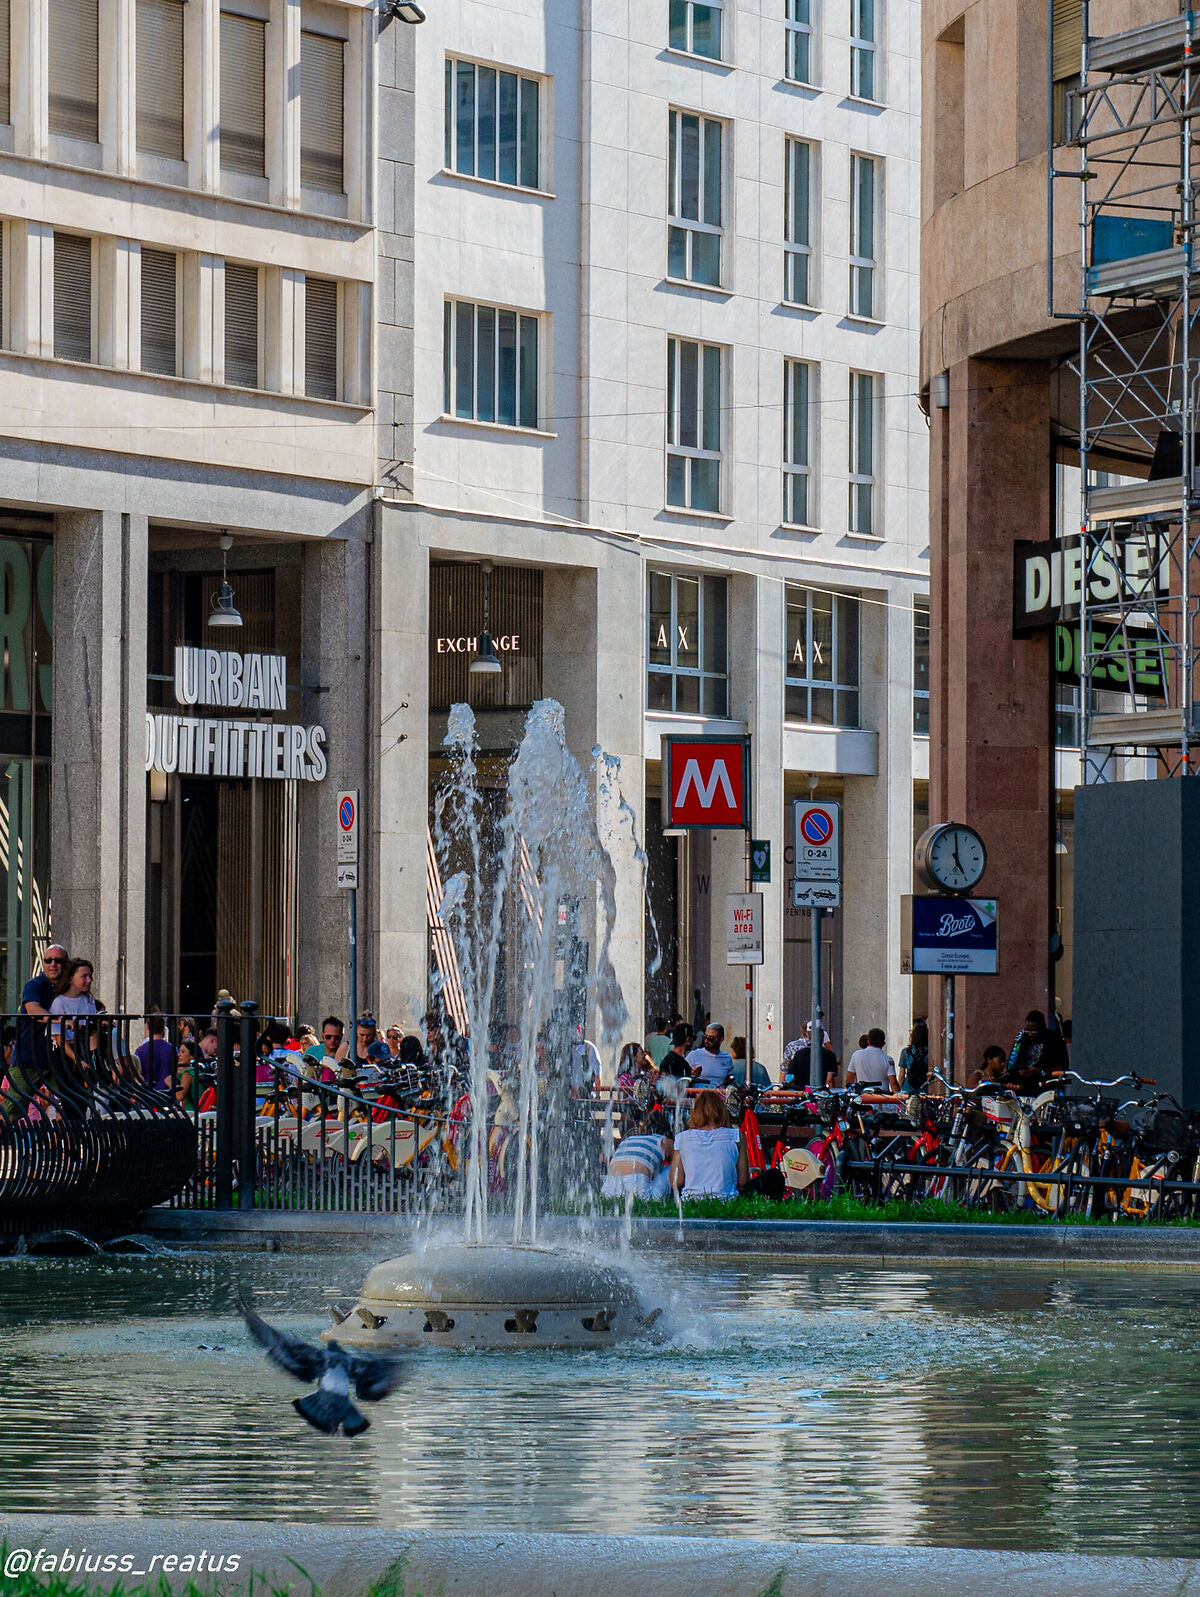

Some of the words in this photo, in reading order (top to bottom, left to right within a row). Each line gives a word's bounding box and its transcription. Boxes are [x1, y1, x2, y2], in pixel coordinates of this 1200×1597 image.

[437, 635, 520, 653] EXCHNGE
[1055, 625, 1170, 686] DIESE
[175, 646, 287, 711] URBAN
[675, 758, 737, 809] M
[807, 849, 828, 858] 0-24
[733, 908, 753, 921] Wi-Fi
[733, 923, 753, 933] area
[936, 913, 976, 938] Boots
